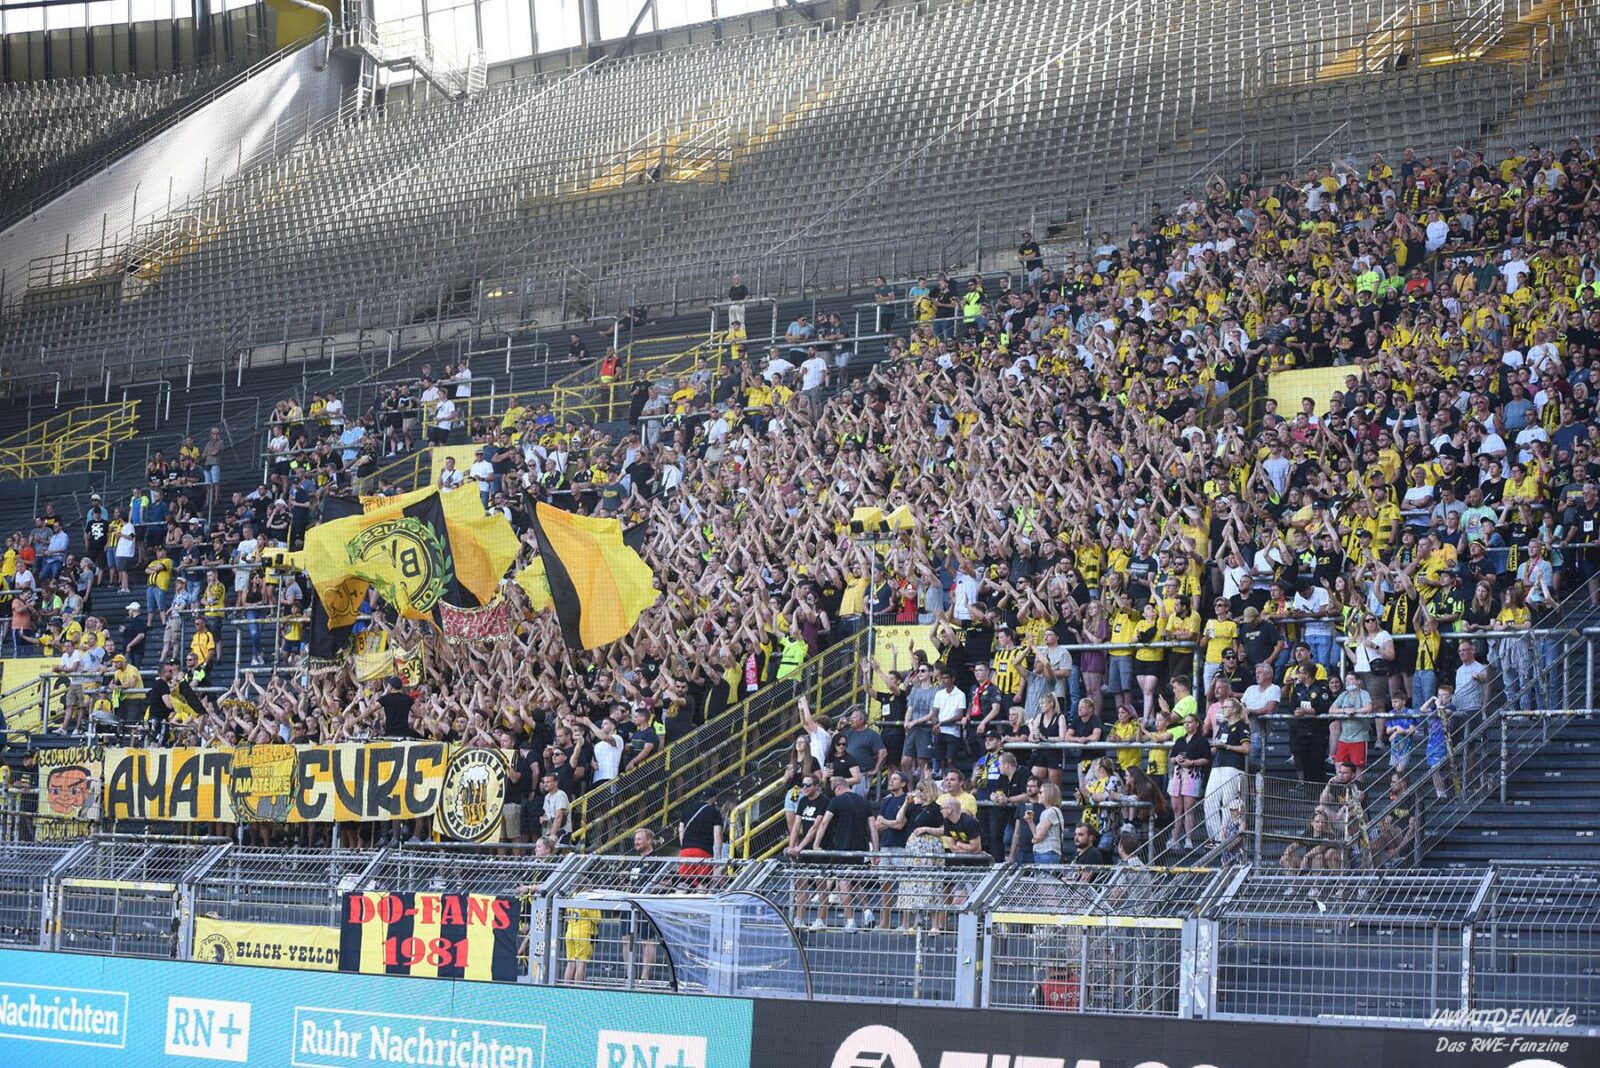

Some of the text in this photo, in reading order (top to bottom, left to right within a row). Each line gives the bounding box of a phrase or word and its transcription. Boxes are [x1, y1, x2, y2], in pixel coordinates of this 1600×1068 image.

[348, 895, 512, 930] DO-FANS
[383, 936, 470, 968] 1981
[300, 1019, 534, 1068] Ruhr Nachrichten
